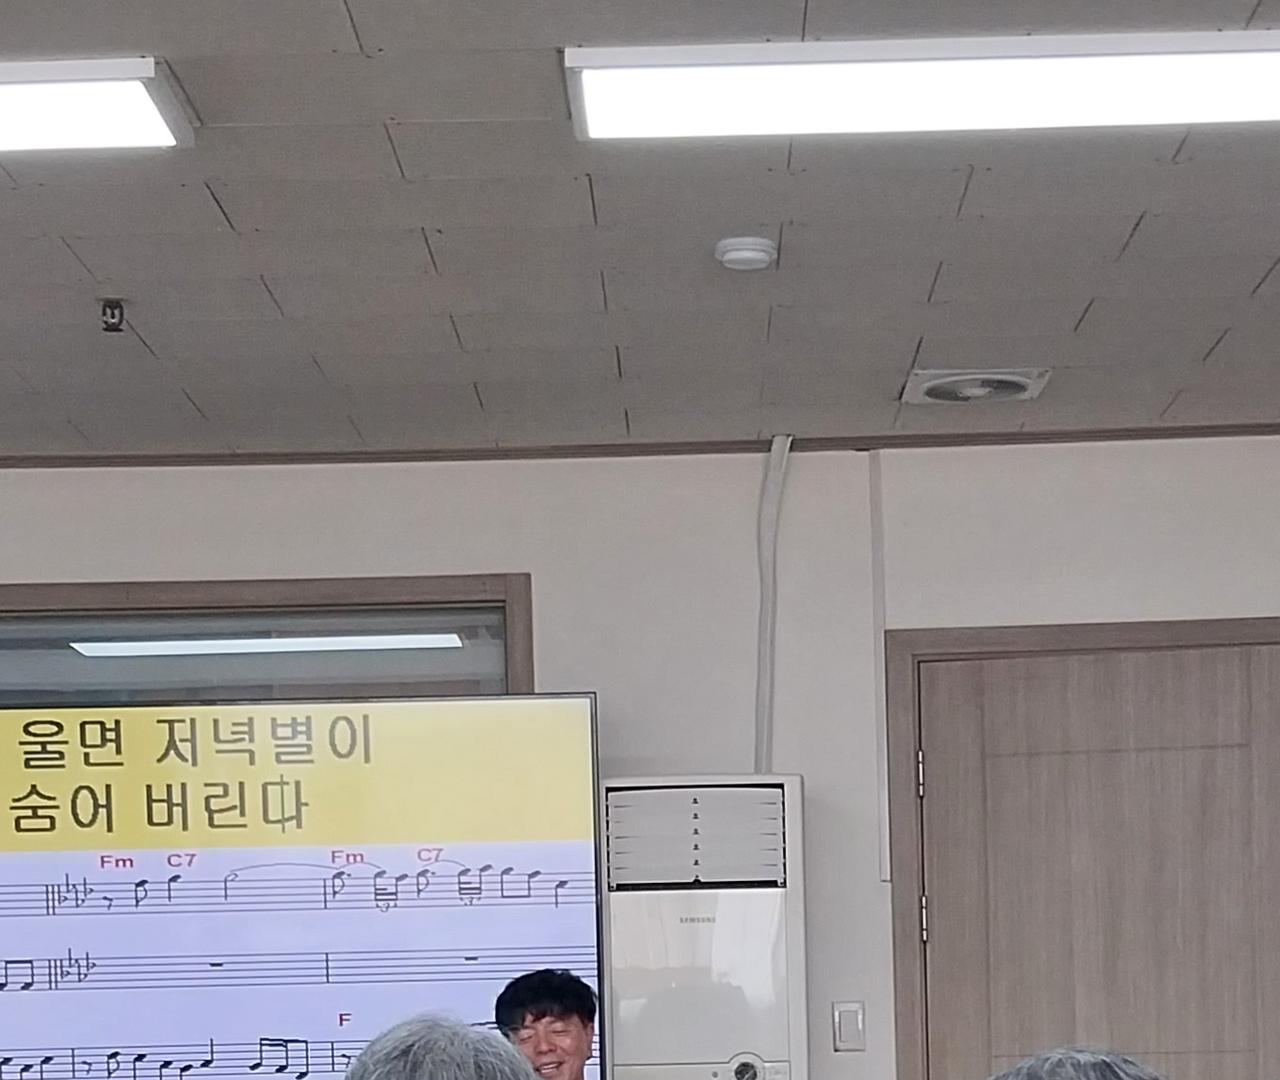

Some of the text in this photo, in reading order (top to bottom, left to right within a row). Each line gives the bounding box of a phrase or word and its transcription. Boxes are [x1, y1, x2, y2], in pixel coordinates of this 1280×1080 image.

[18, 717, 125, 770] 울면
[157, 713, 373, 769] 저녁별이
[9, 778, 309, 834] 숨어 버린다
[99, 855, 135, 869] Fm
[167, 853, 197, 868] C7
[331, 850, 365, 864] Fm
[417, 848, 444, 863] C7
[338, 1013, 352, 1027] F
